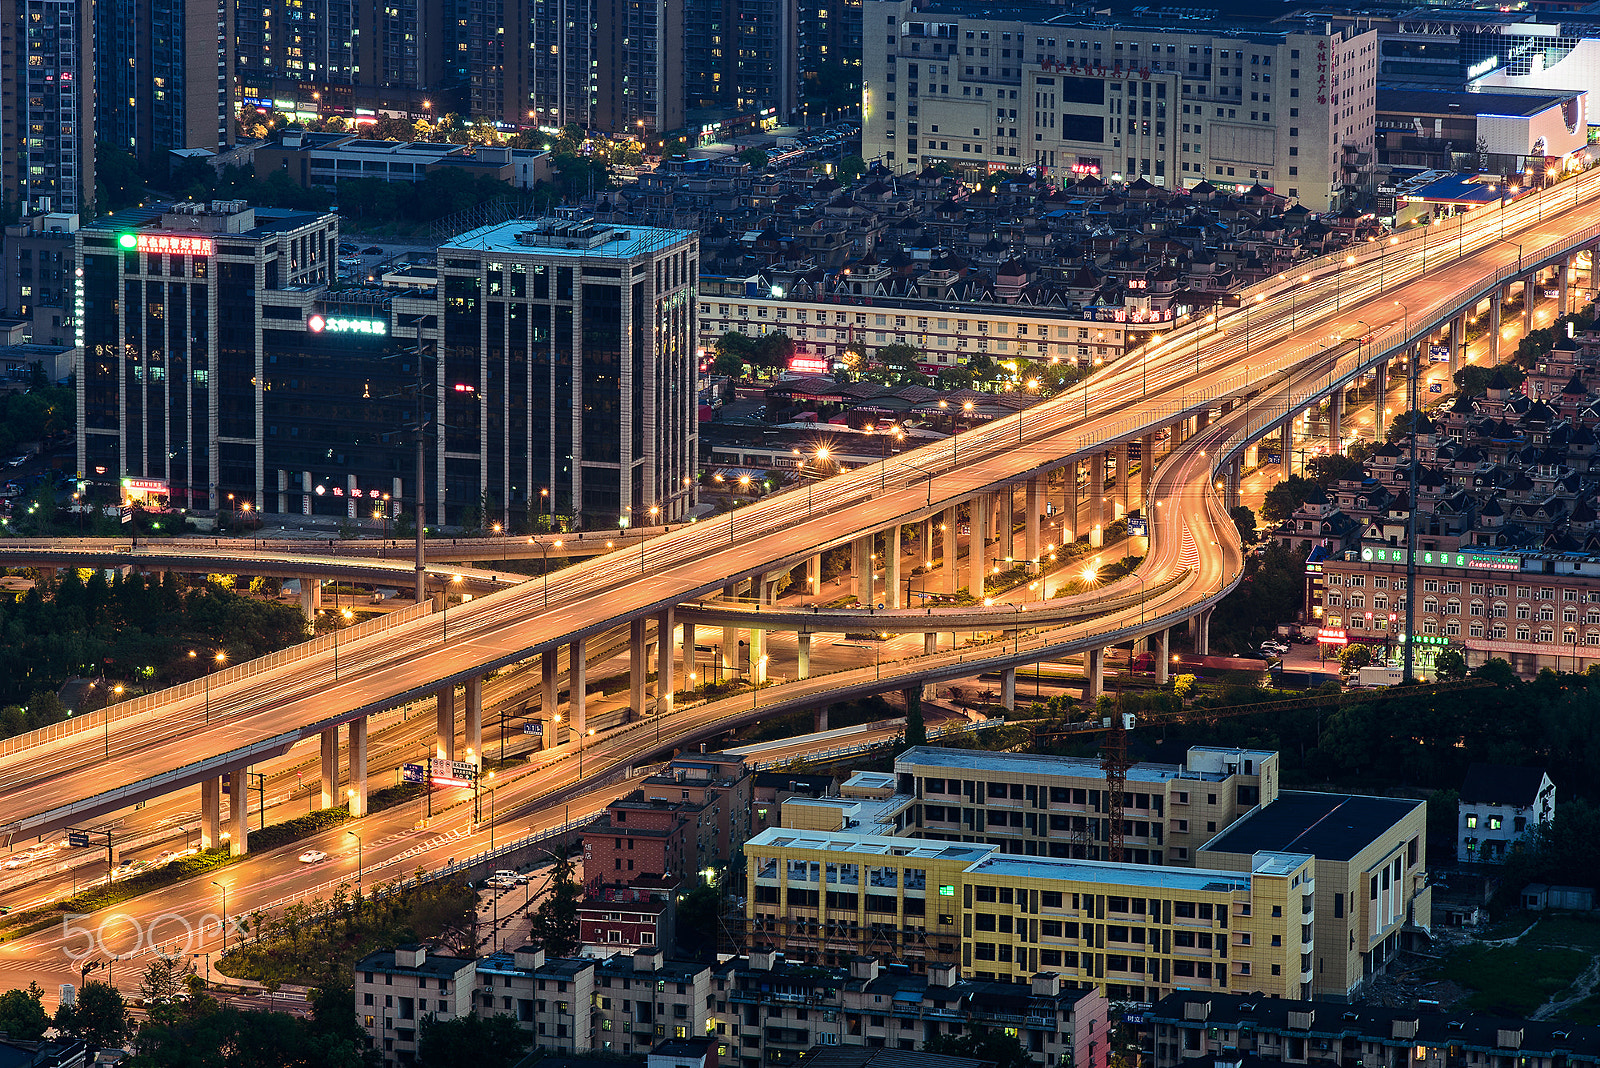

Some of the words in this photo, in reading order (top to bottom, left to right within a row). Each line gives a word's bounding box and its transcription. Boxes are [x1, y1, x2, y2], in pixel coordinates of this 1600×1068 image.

[1041, 58, 1151, 80] 浙江永佳灯具广场
[1317, 40, 1327, 105] 永佳灯具广场
[137, 235, 212, 251] 维也纳智好酒店
[1128, 281, 1147, 289] 如家
[1114, 308, 1172, 323] 如家酒店
[333, 487, 381, 499] 住院部
[1377, 549, 1465, 567] 格林泰酒店
[584, 843, 593, 860] 饭店
